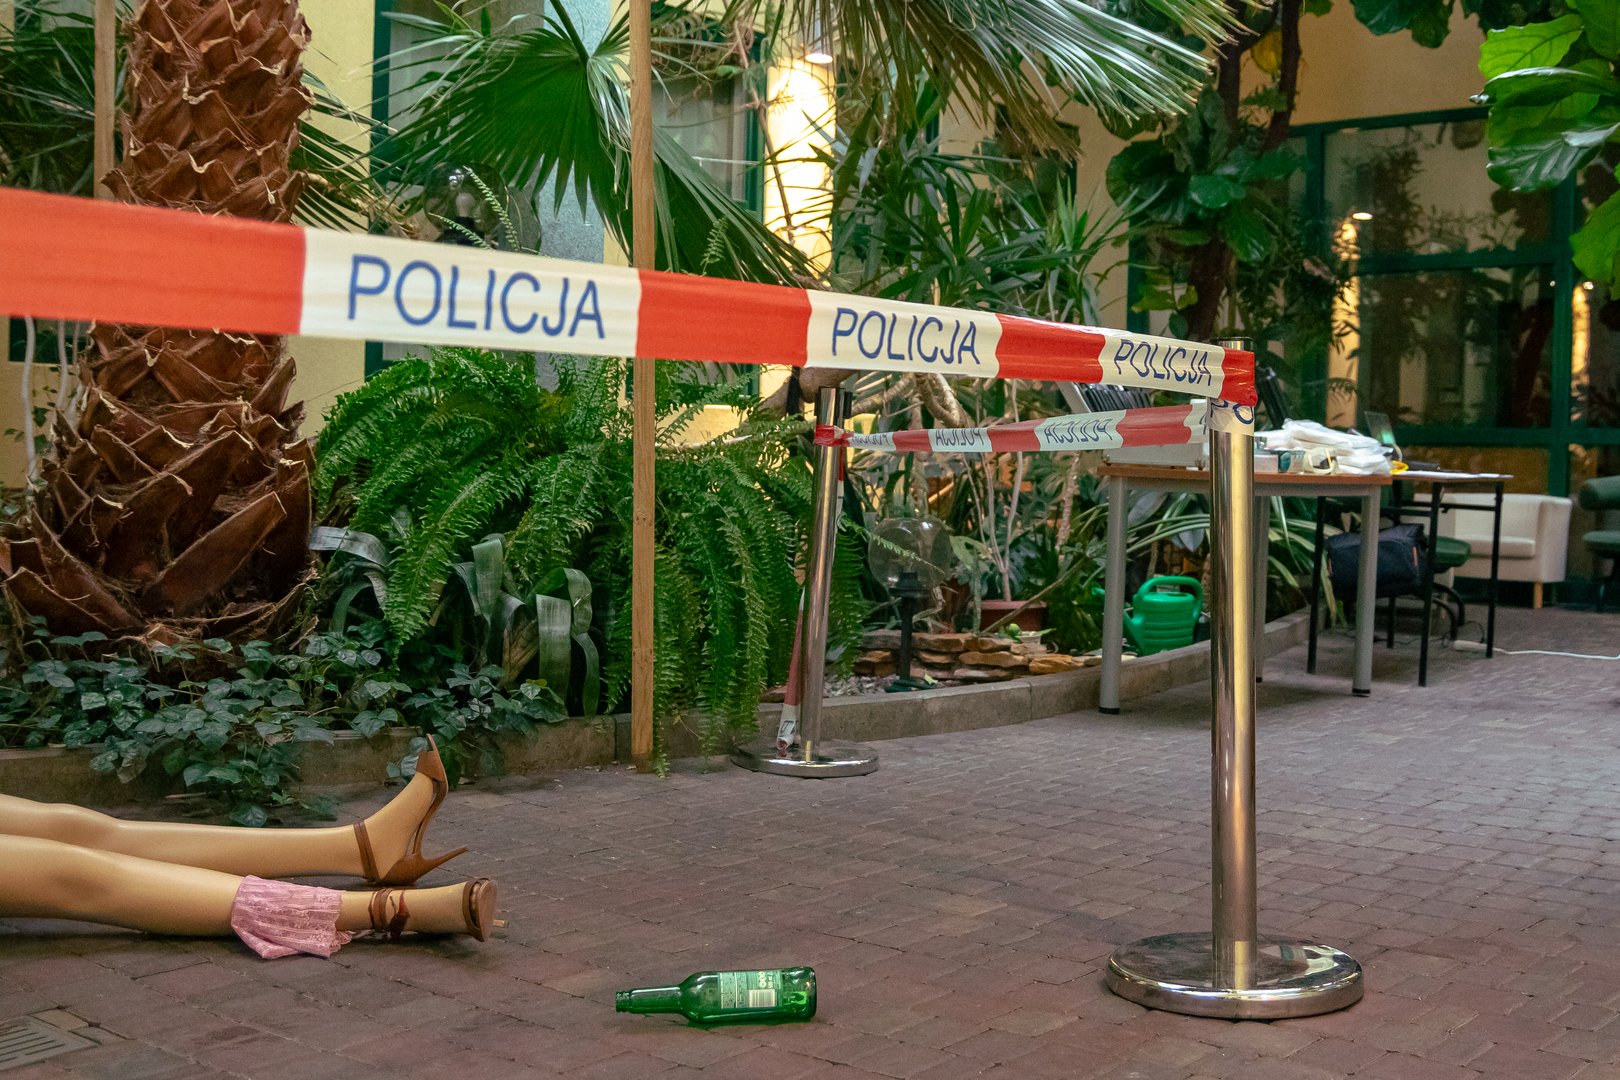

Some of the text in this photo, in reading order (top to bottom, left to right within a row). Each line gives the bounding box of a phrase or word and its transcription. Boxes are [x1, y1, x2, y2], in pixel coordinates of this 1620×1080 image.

[348, 254, 1212, 387] POLICJA POLICJA POLICJA
